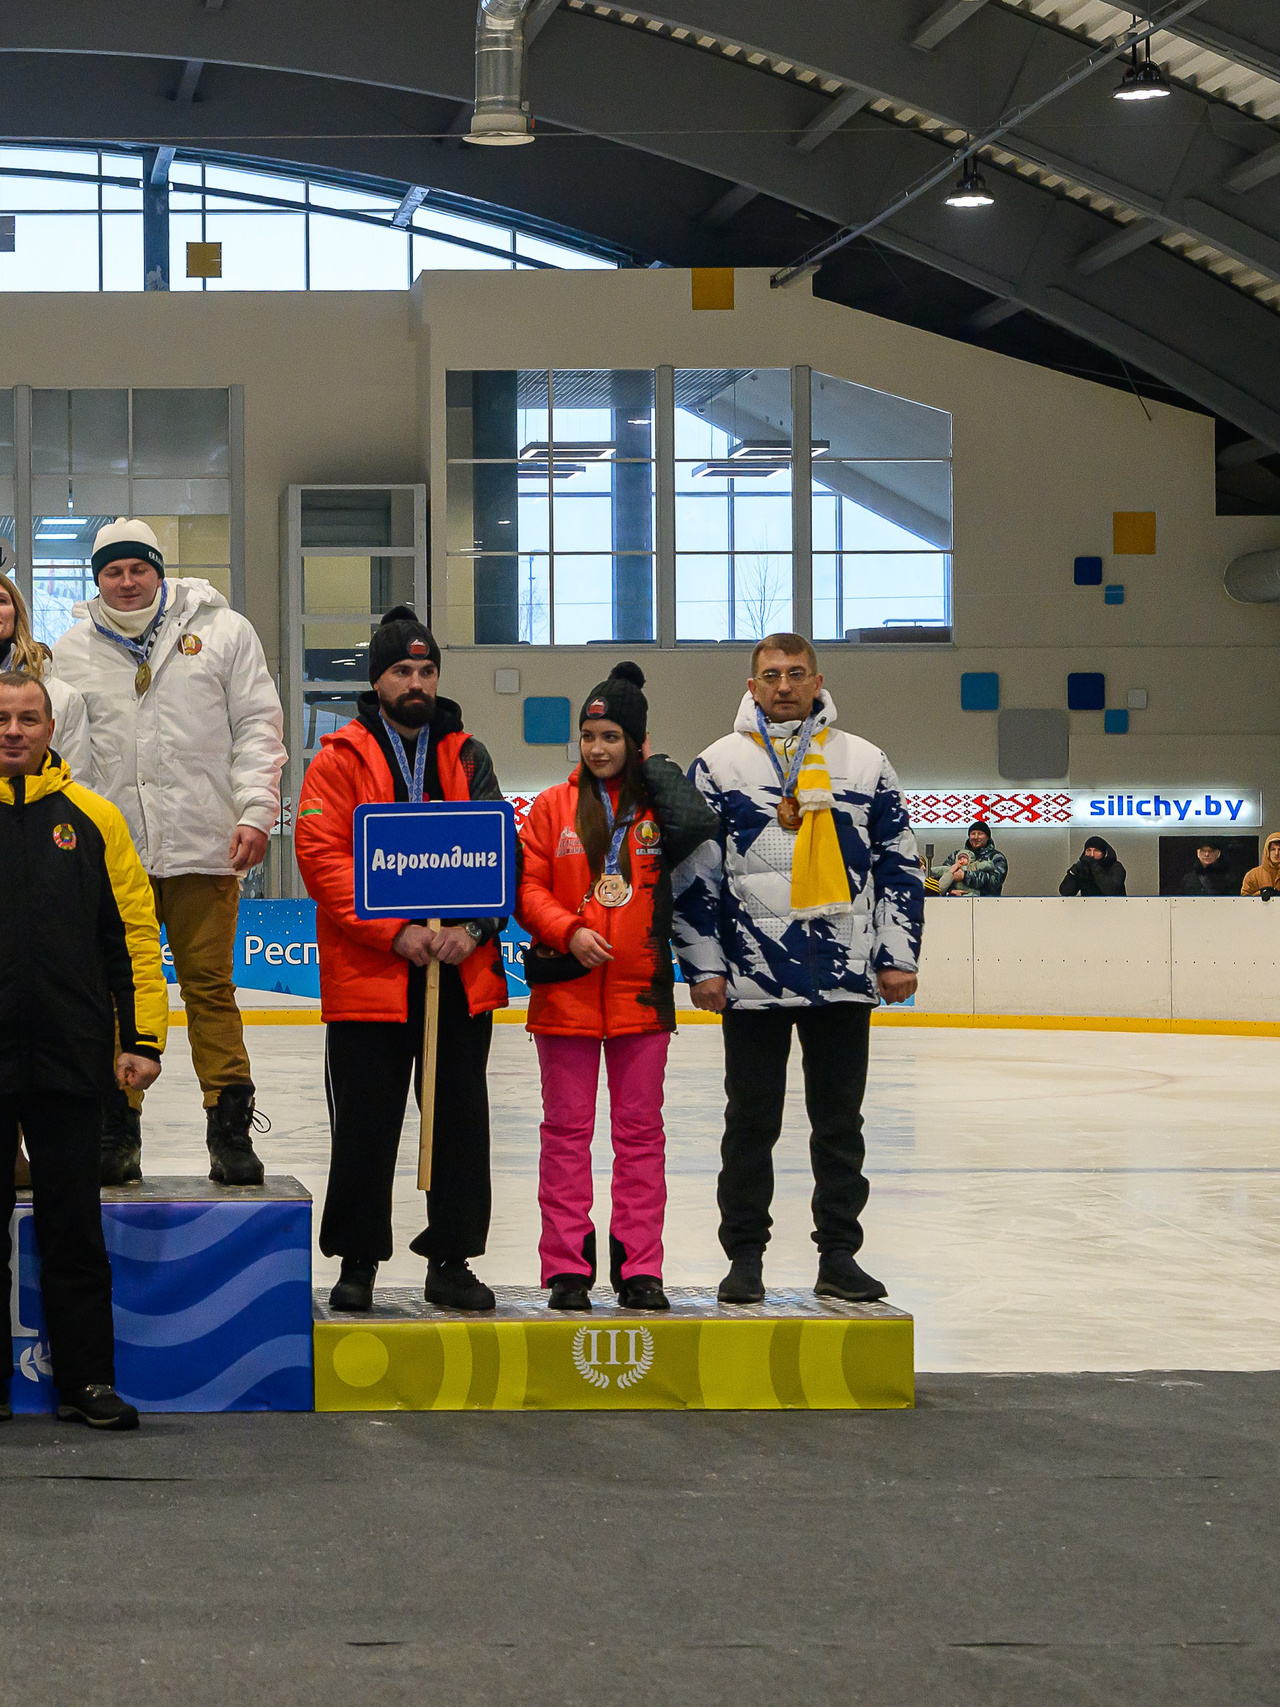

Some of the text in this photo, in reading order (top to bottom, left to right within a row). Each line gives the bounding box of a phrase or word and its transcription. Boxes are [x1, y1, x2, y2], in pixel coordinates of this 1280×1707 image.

[1090, 795, 1244, 821] silichy.by
[371, 845, 498, 876] Агрохолдинг
[585, 1328, 643, 1366] III
